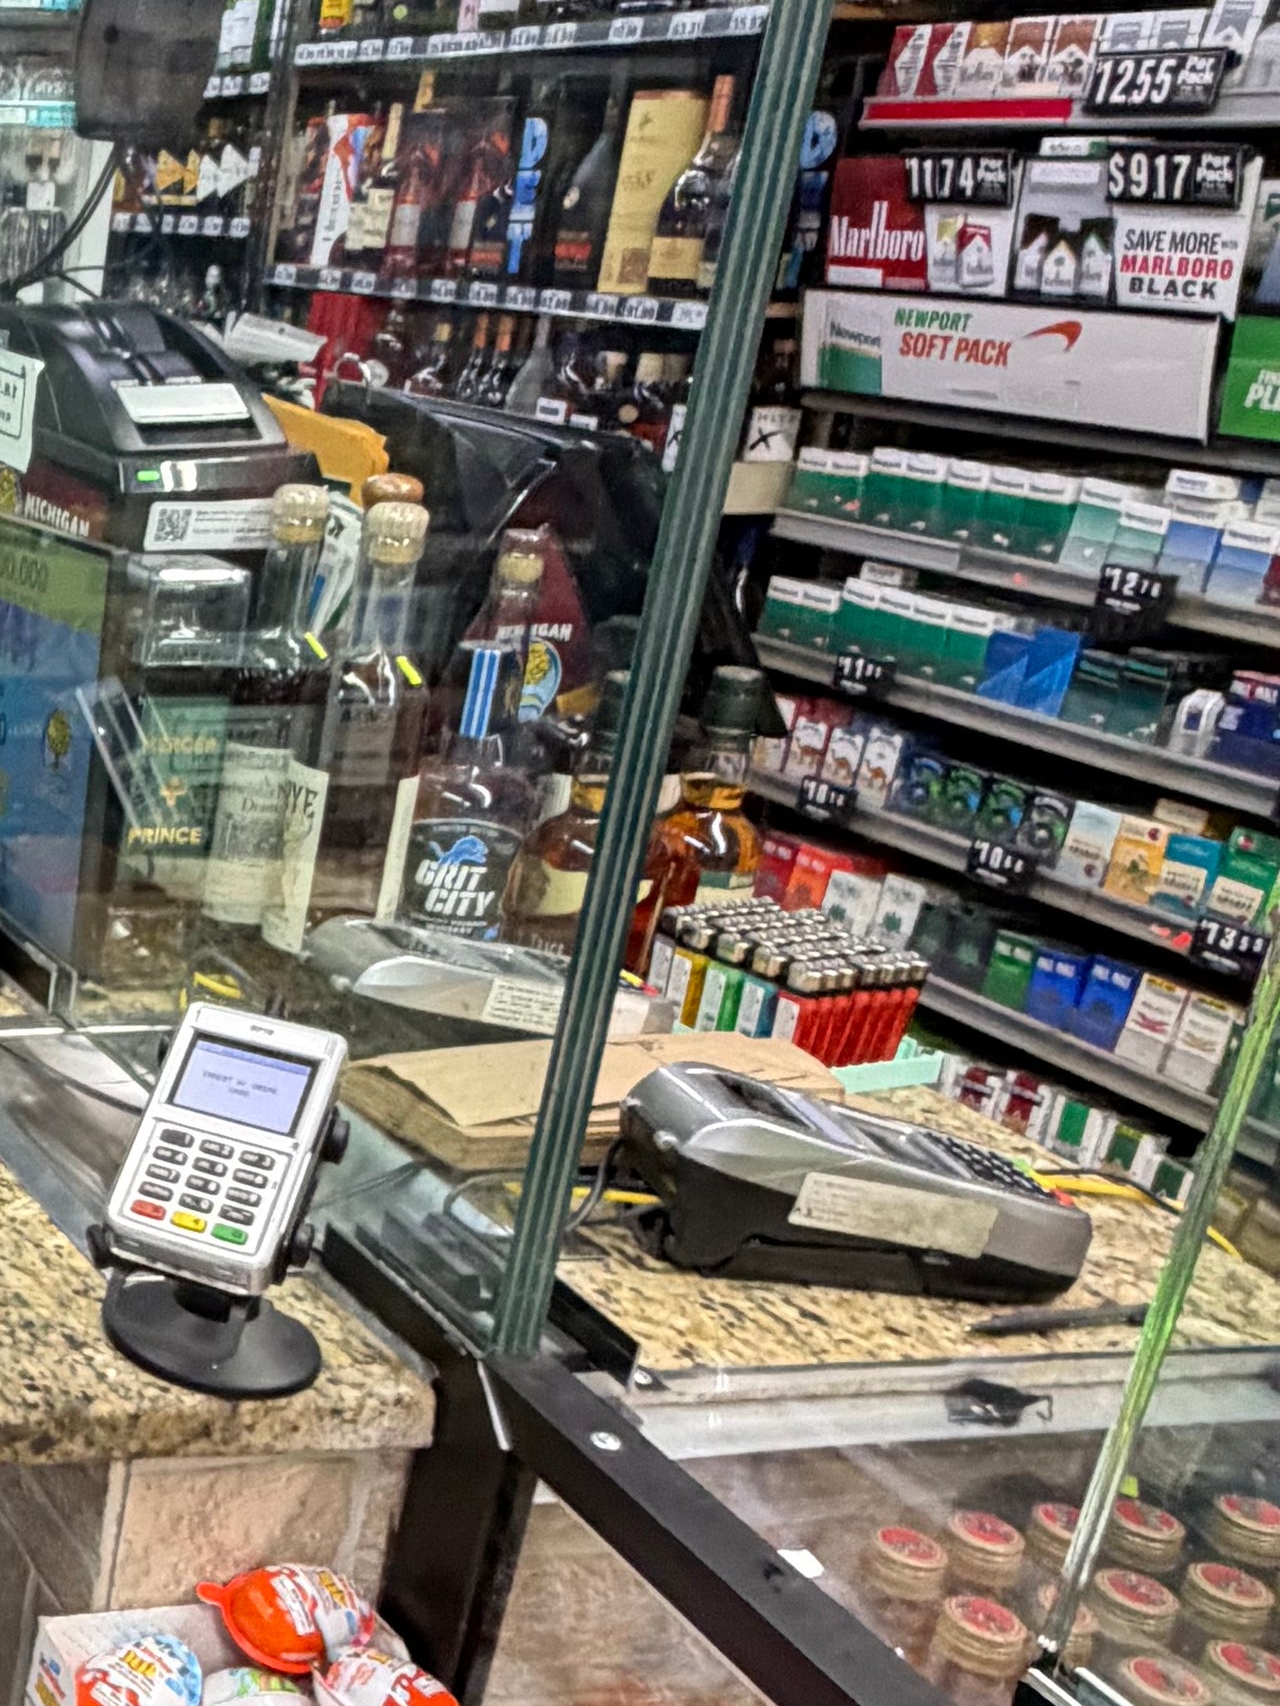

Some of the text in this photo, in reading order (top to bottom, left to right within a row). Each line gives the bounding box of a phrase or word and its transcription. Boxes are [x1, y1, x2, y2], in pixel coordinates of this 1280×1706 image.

[829, 199, 926, 263] Marlboro
[1123, 227, 1167, 253] SAVE
[1171, 231, 1222, 256] MORE
[1119, 254, 1235, 282] MARLBORO
[1129, 276, 1219, 301] BLACK
[893, 307, 973, 333] NEWPORT
[899, 331, 1012, 368] SOFT PACK
[24, 493, 91, 539] MICHIGAN
[127, 825, 203, 846] PRINCE
[414, 858, 489, 892] GRIT
[424, 887, 496, 918] CITY
